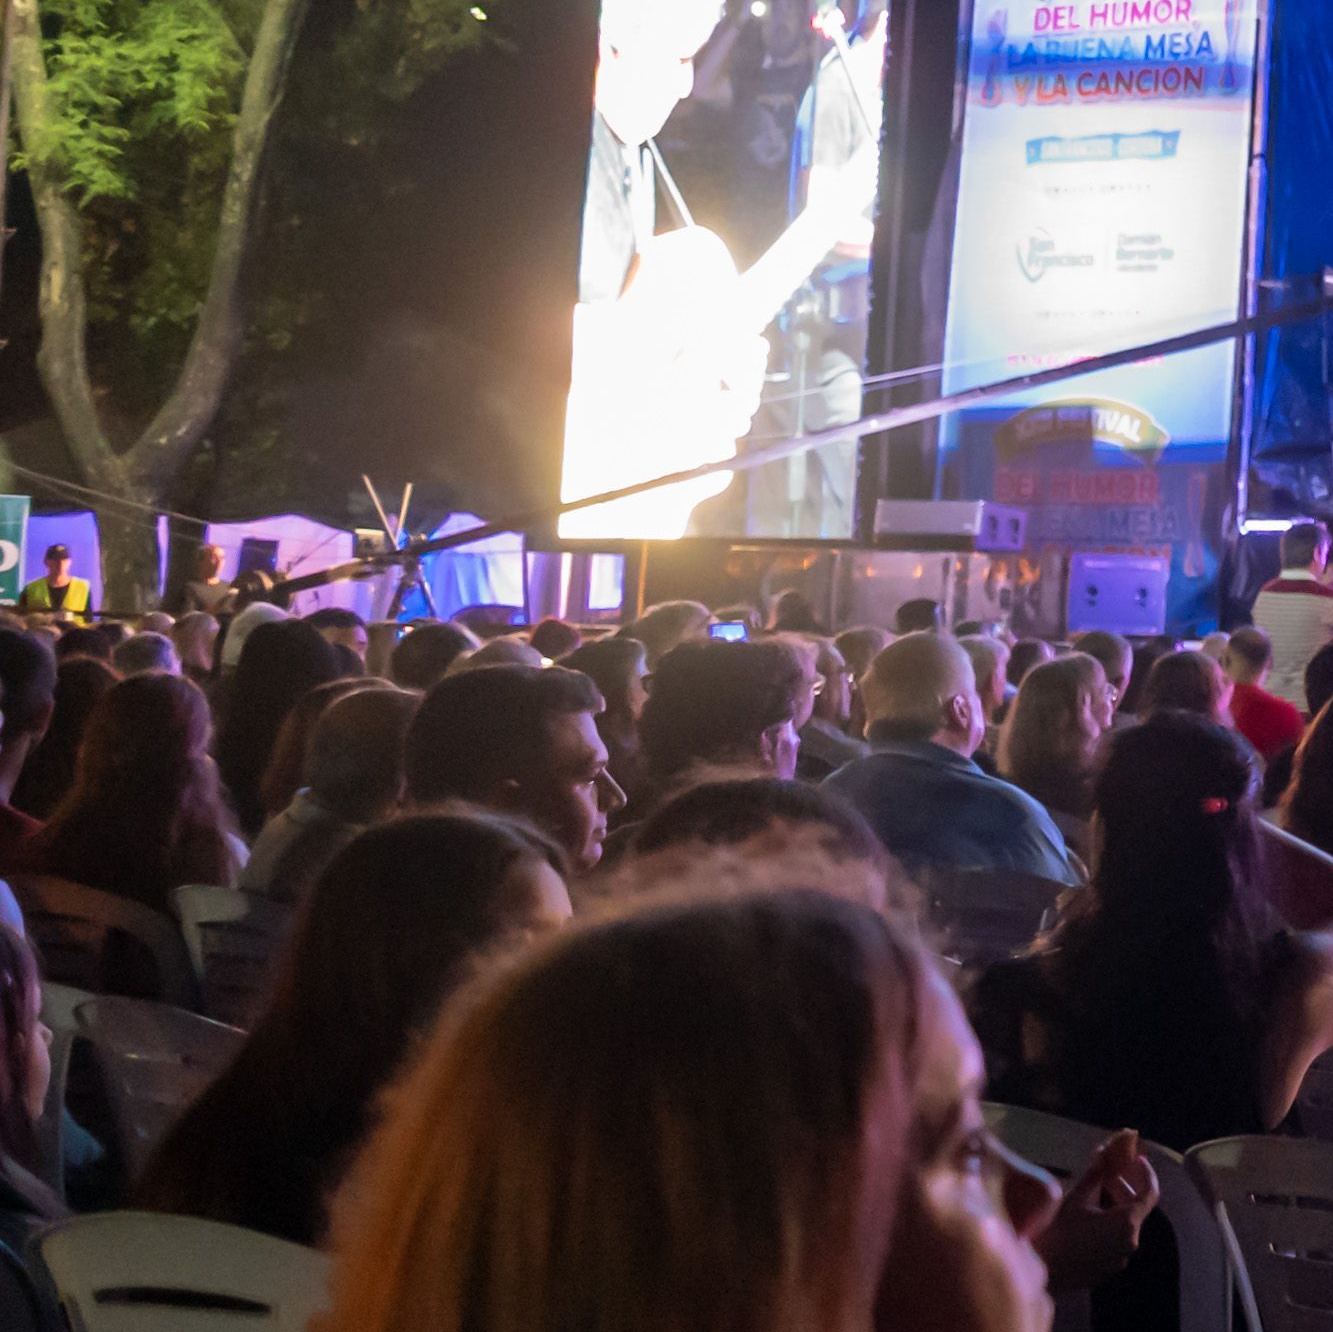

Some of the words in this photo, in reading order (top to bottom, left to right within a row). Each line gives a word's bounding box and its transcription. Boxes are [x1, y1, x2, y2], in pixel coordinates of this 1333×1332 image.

[1034, 6, 1080, 32] DEL
[1046, 35, 1135, 60] BUENA
[1144, 31, 1215, 61] MESA
[1014, 74, 1032, 105] Y
[1036, 71, 1069, 103] LA
[1076, 64, 1205, 99] CANCIÓN
